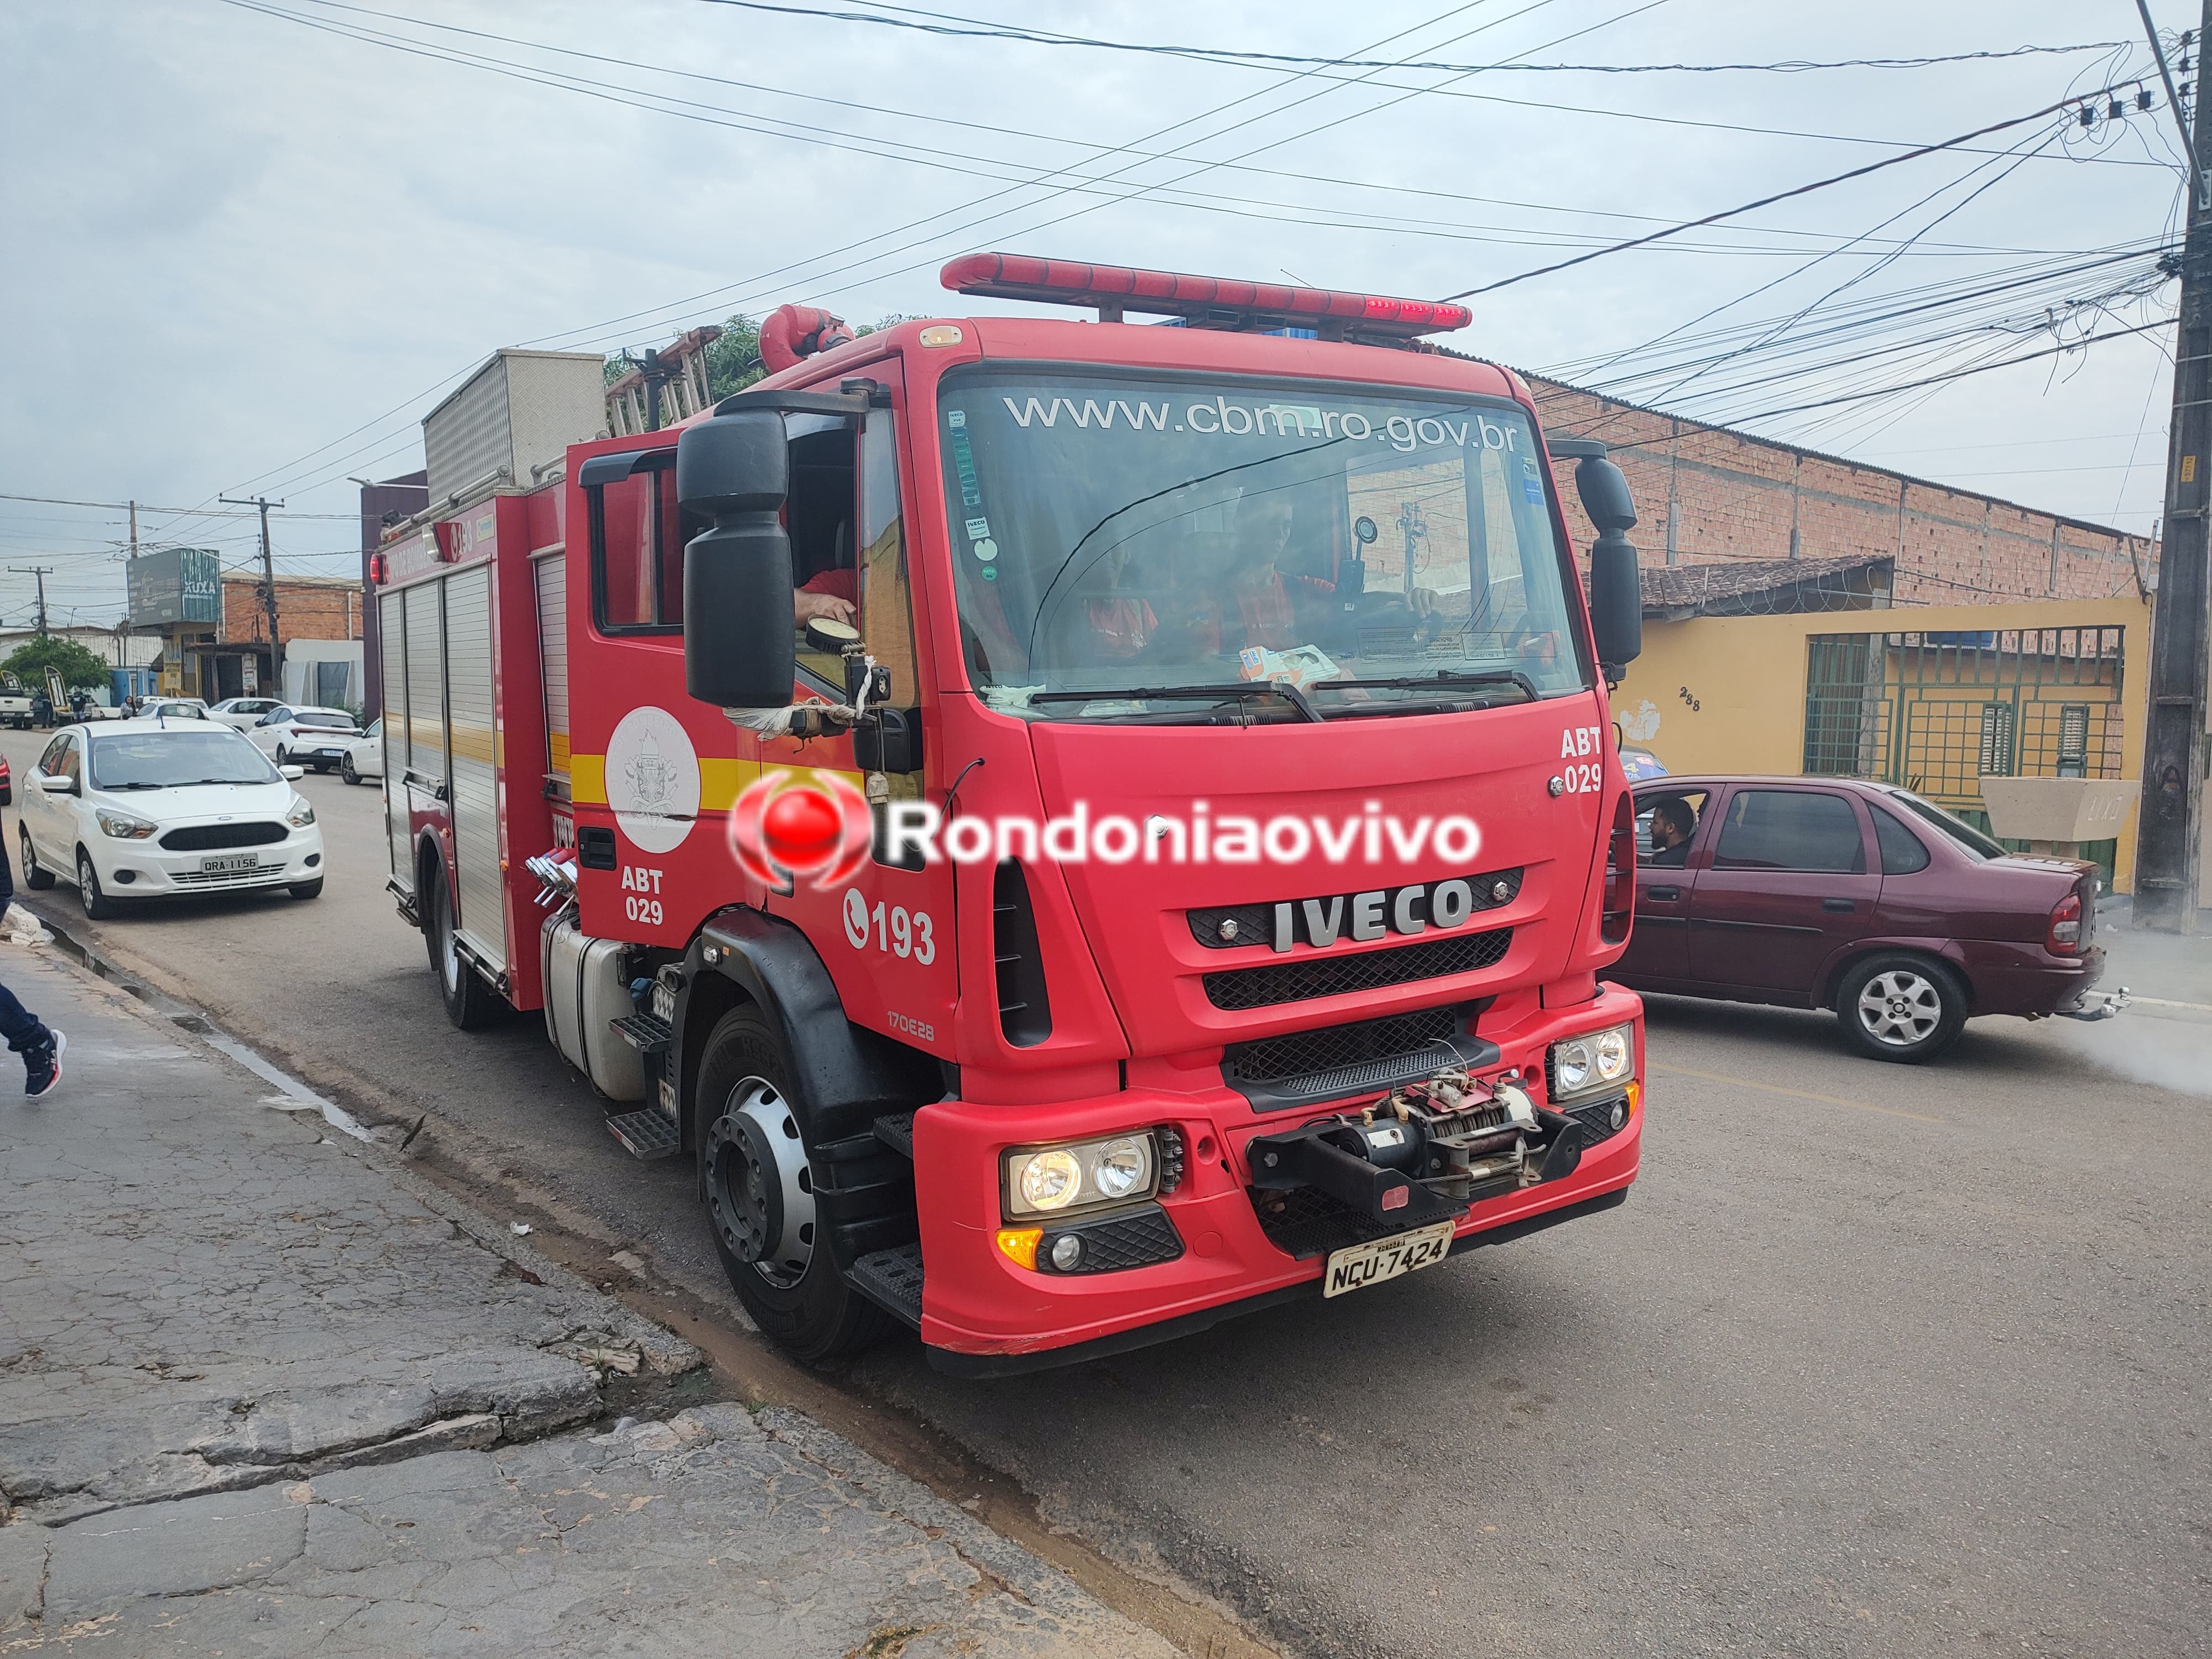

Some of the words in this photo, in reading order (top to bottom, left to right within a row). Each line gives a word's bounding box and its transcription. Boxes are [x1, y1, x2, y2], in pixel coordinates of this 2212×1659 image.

[1002, 396, 1517, 452] www.cbm.ro.gov.br
[457, 520, 473, 555] 193
[1679, 686, 1700, 711] 288
[1561, 727, 1600, 758] ABT
[1565, 763, 1601, 793] 029
[622, 865, 663, 894] ABT
[625, 896, 663, 925] 029
[1274, 880, 1472, 953] IVECO
[873, 901, 935, 965] 193
[888, 1011, 934, 1041] 170E28
